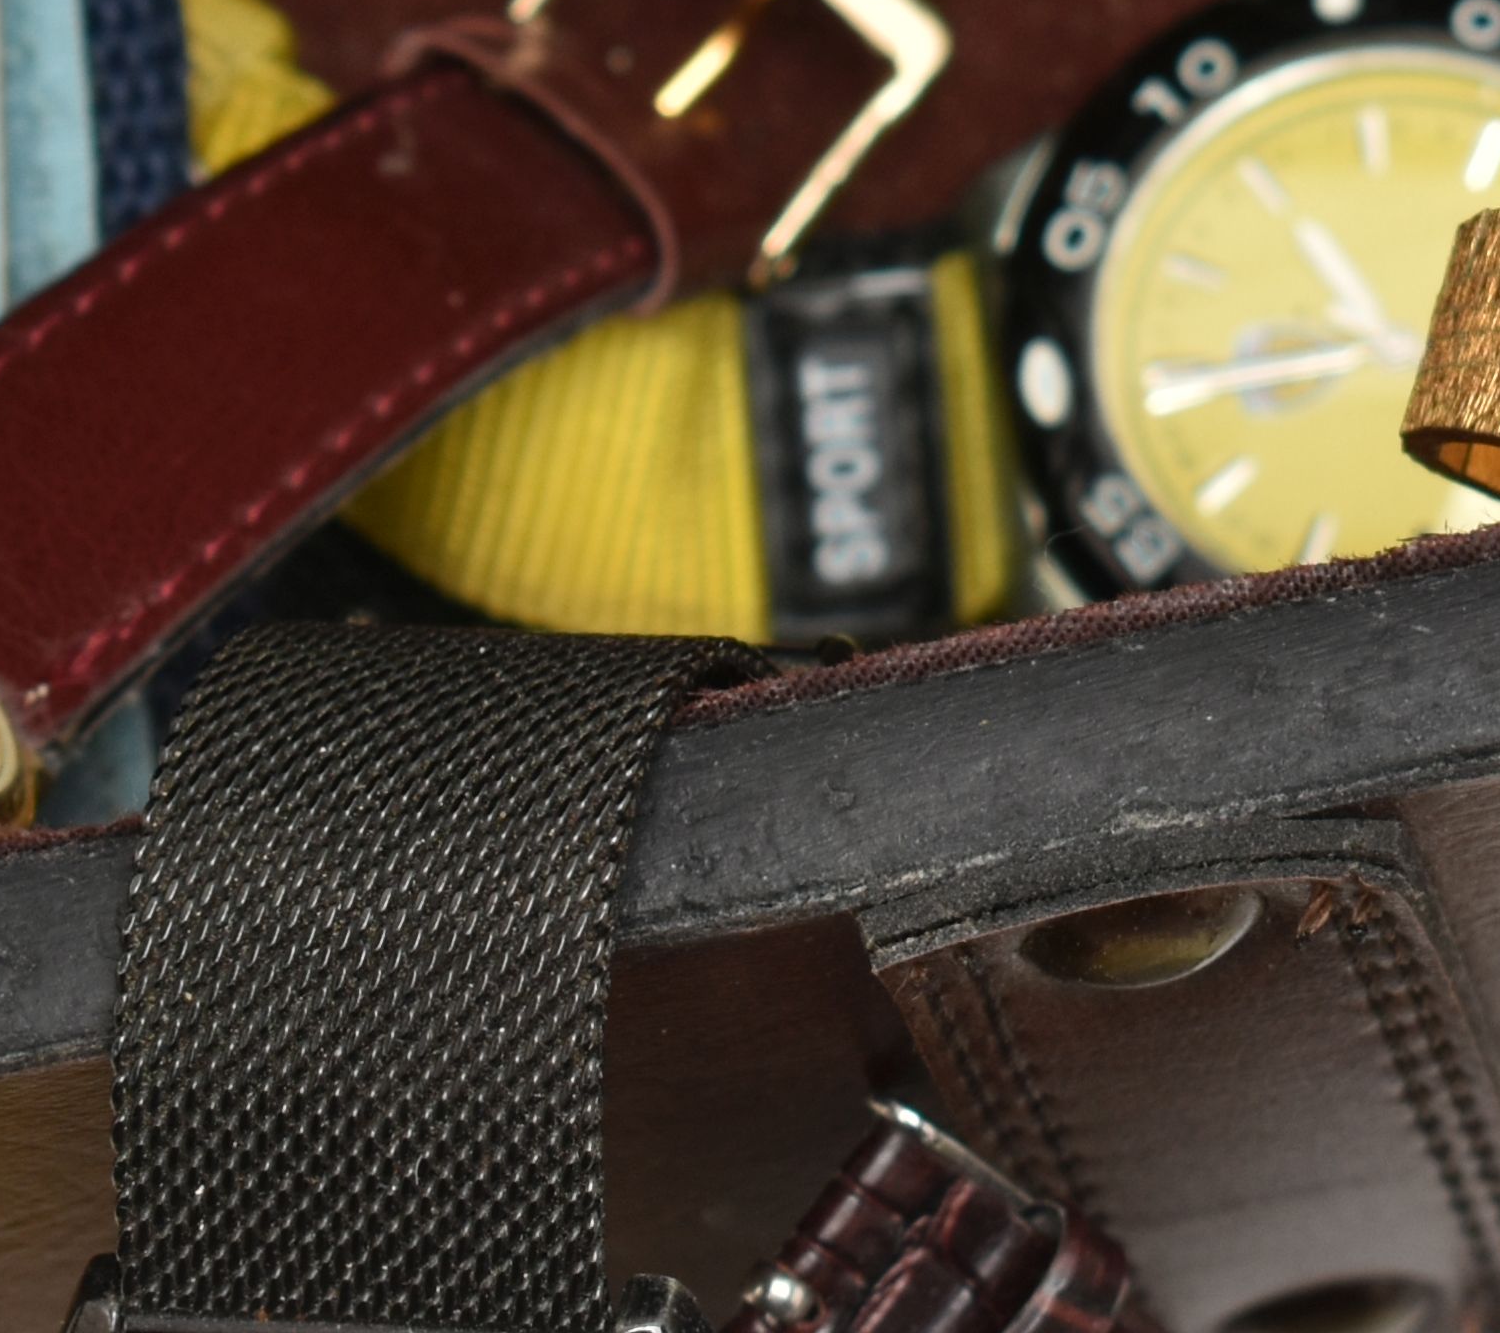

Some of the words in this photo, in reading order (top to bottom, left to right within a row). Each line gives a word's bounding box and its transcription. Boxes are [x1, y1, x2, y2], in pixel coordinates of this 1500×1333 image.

[1129, 39, 1240, 126] 10
[1043, 159, 1127, 271] 05
[797, 352, 891, 585] SPORT
